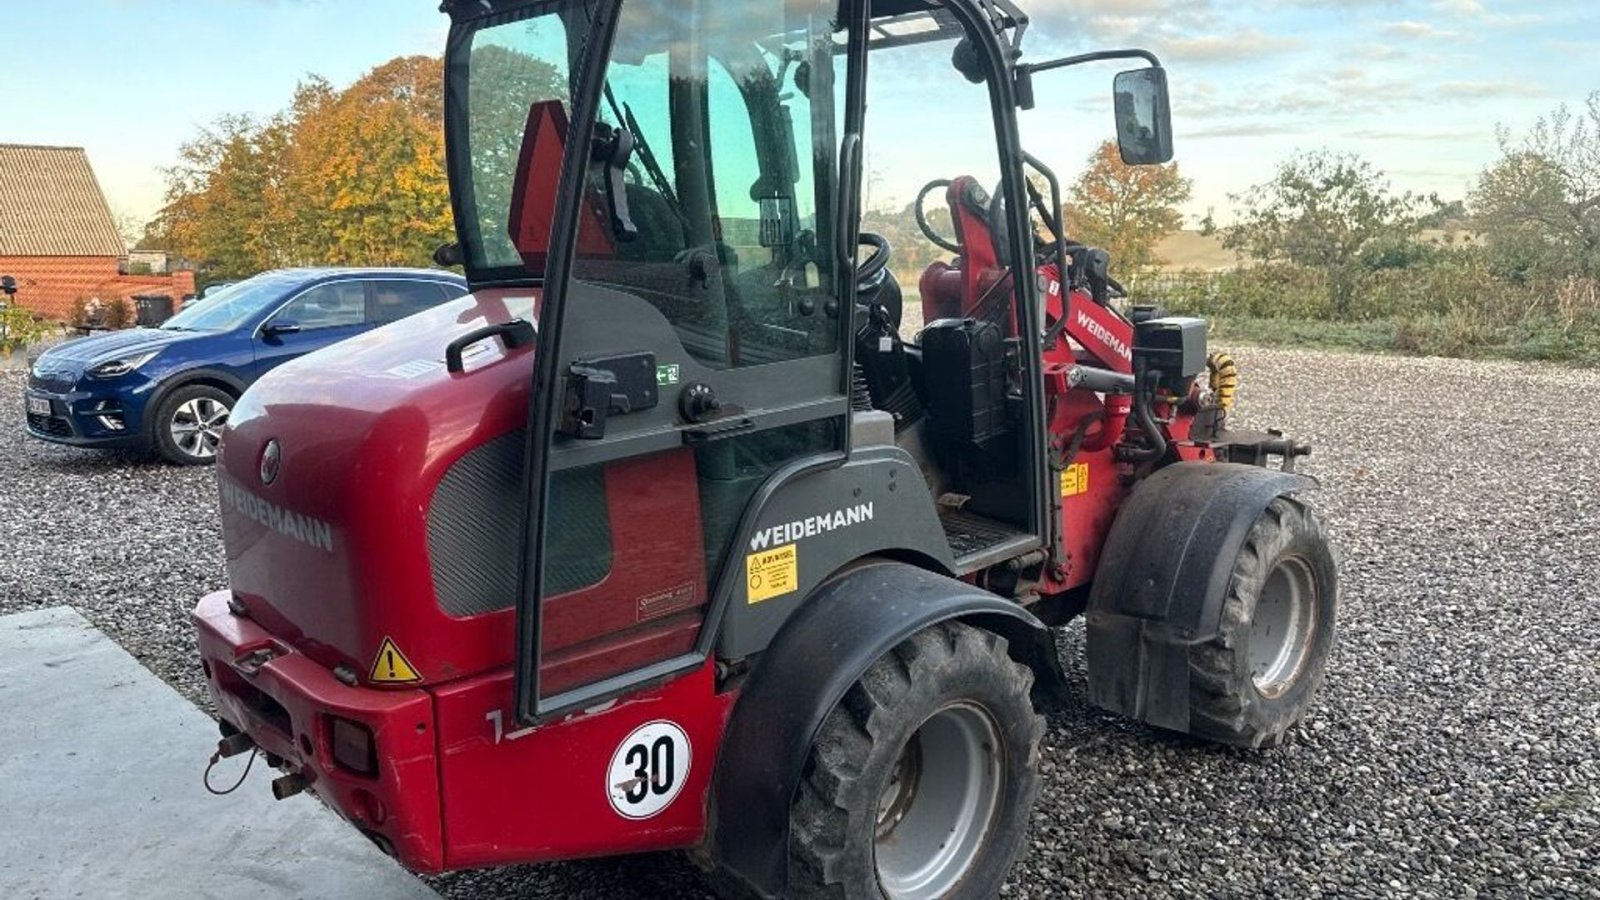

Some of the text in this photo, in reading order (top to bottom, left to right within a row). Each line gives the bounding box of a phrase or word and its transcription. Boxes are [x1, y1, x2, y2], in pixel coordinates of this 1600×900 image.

[218, 479, 333, 553] WEIDEMANN
[750, 501, 873, 551] WEIDEMANN
[625, 735, 674, 804] 30
